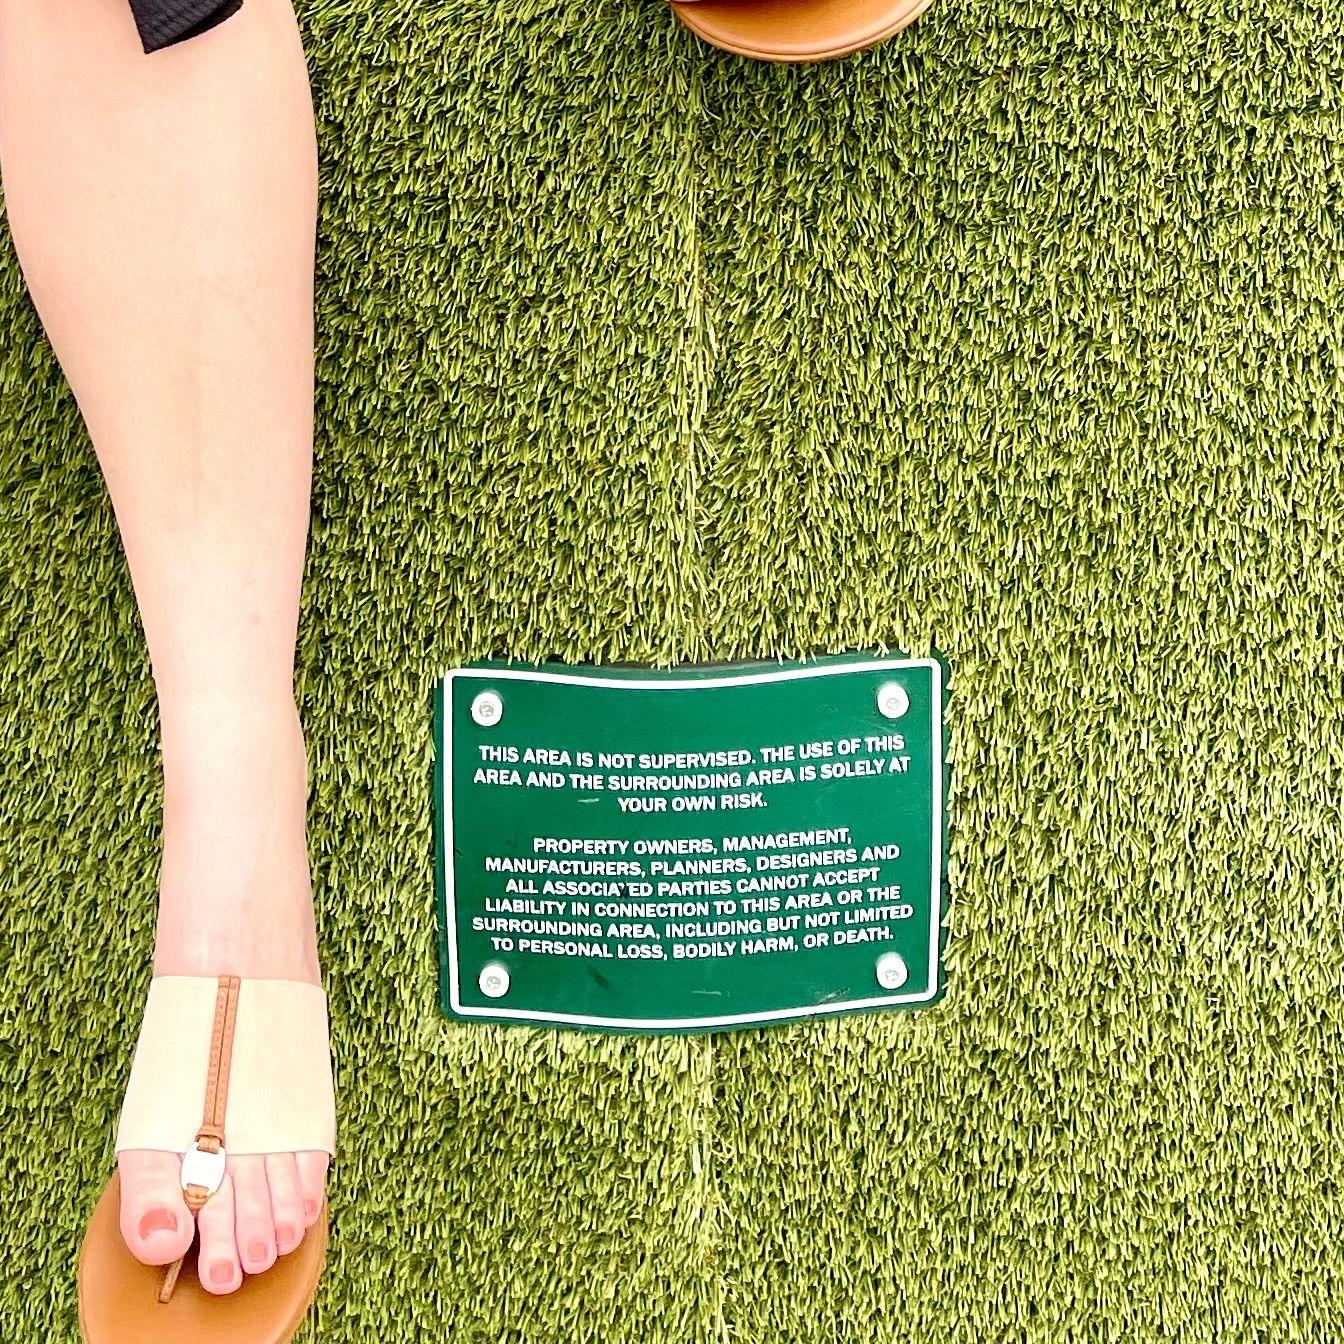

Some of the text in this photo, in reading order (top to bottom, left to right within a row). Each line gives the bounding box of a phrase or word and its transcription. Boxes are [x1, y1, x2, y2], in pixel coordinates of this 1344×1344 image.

[479, 733, 904, 768] THIS AREA IS NOT SUPERVISED. THE USE OF THIS
[474, 756, 911, 790] AREA AND THE SURROUNDING AREA IS SOLELY AT
[617, 792, 767, 812] YOUR OWN RISK.
[534, 828, 851, 855] PROPERTY OWNERS, MANAGEMENT,
[486, 845, 899, 878] MANUFACTURERS, PLANNERS, DESIGNERS AND
[506, 879, 538, 893] ALL
[658, 879, 732, 896] PARTIES
[736, 874, 809, 893] CANNOT
[813, 867, 880, 887] ACCEPT
[486, 886, 900, 917] LIABILITY IN CONNECTION TO THIS AREA OR THE
[473, 905, 913, 940] SURROUNDING AREA, INCLUDING BUT NOT LIMITED
[491, 926, 893, 960] TO PERSONAL LOSS, BODILY HARM, OR DEATH.
